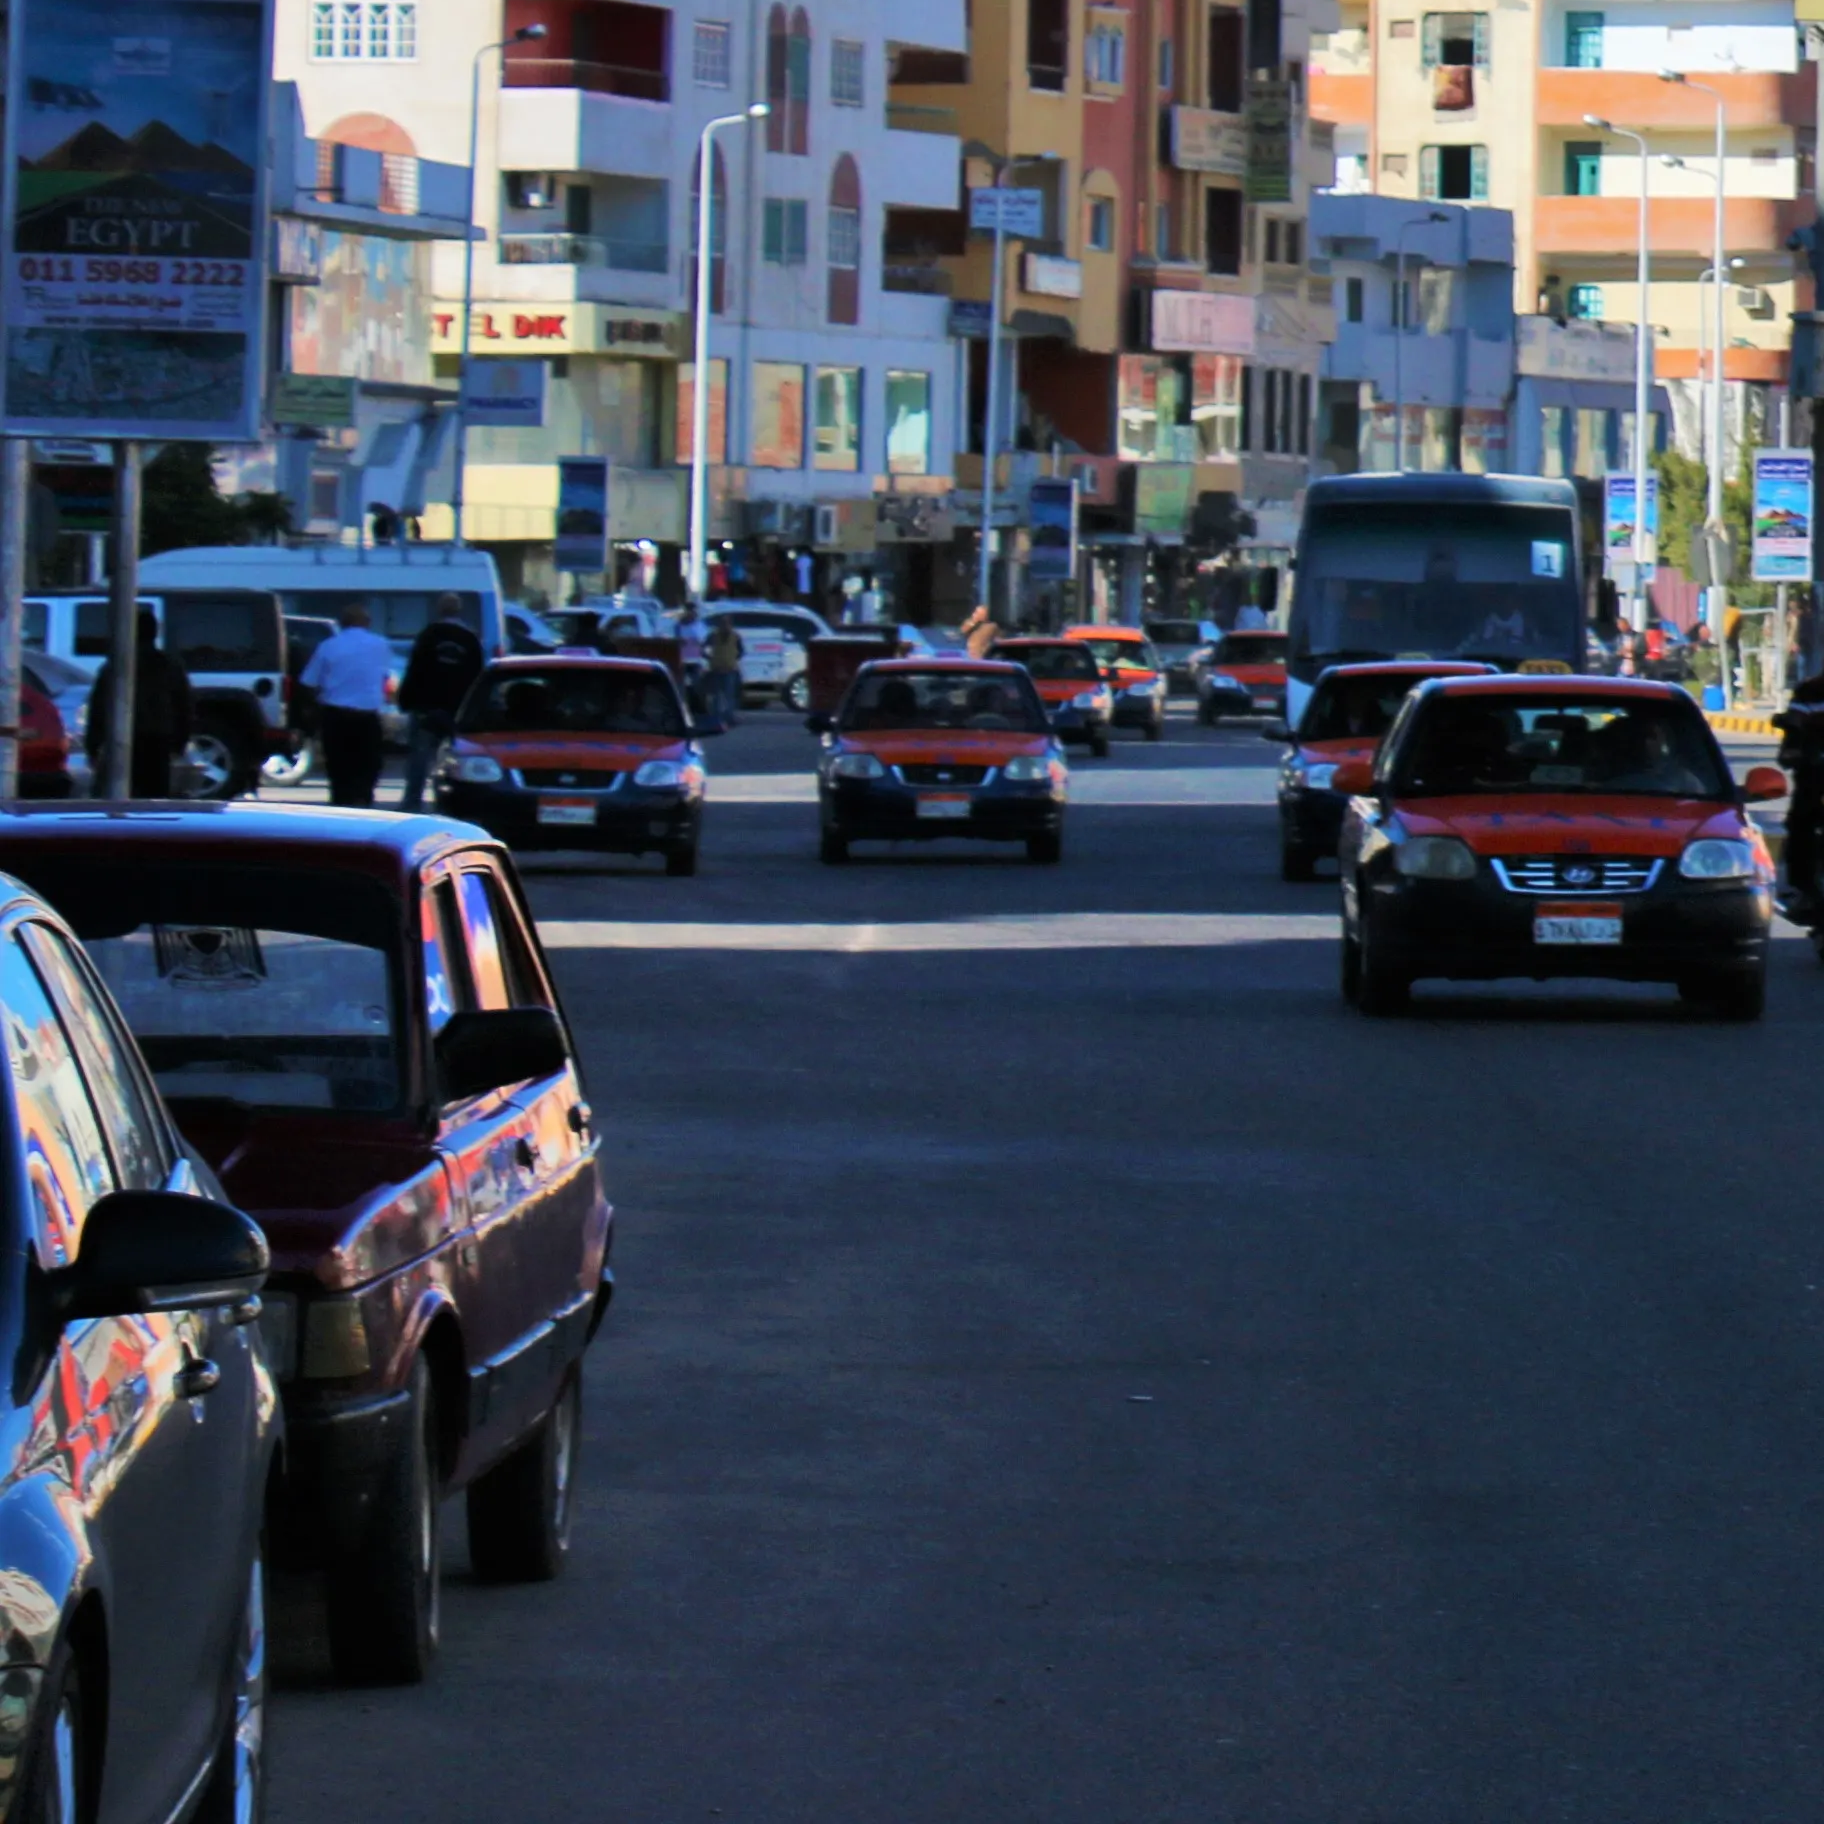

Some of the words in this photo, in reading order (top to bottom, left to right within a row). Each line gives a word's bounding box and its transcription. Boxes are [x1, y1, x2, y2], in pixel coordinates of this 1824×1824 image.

[66, 216, 200, 249] EGYPT
[19, 257, 75, 282] 011
[85, 258, 161, 284] 5968
[171, 260, 245, 287] 2222
